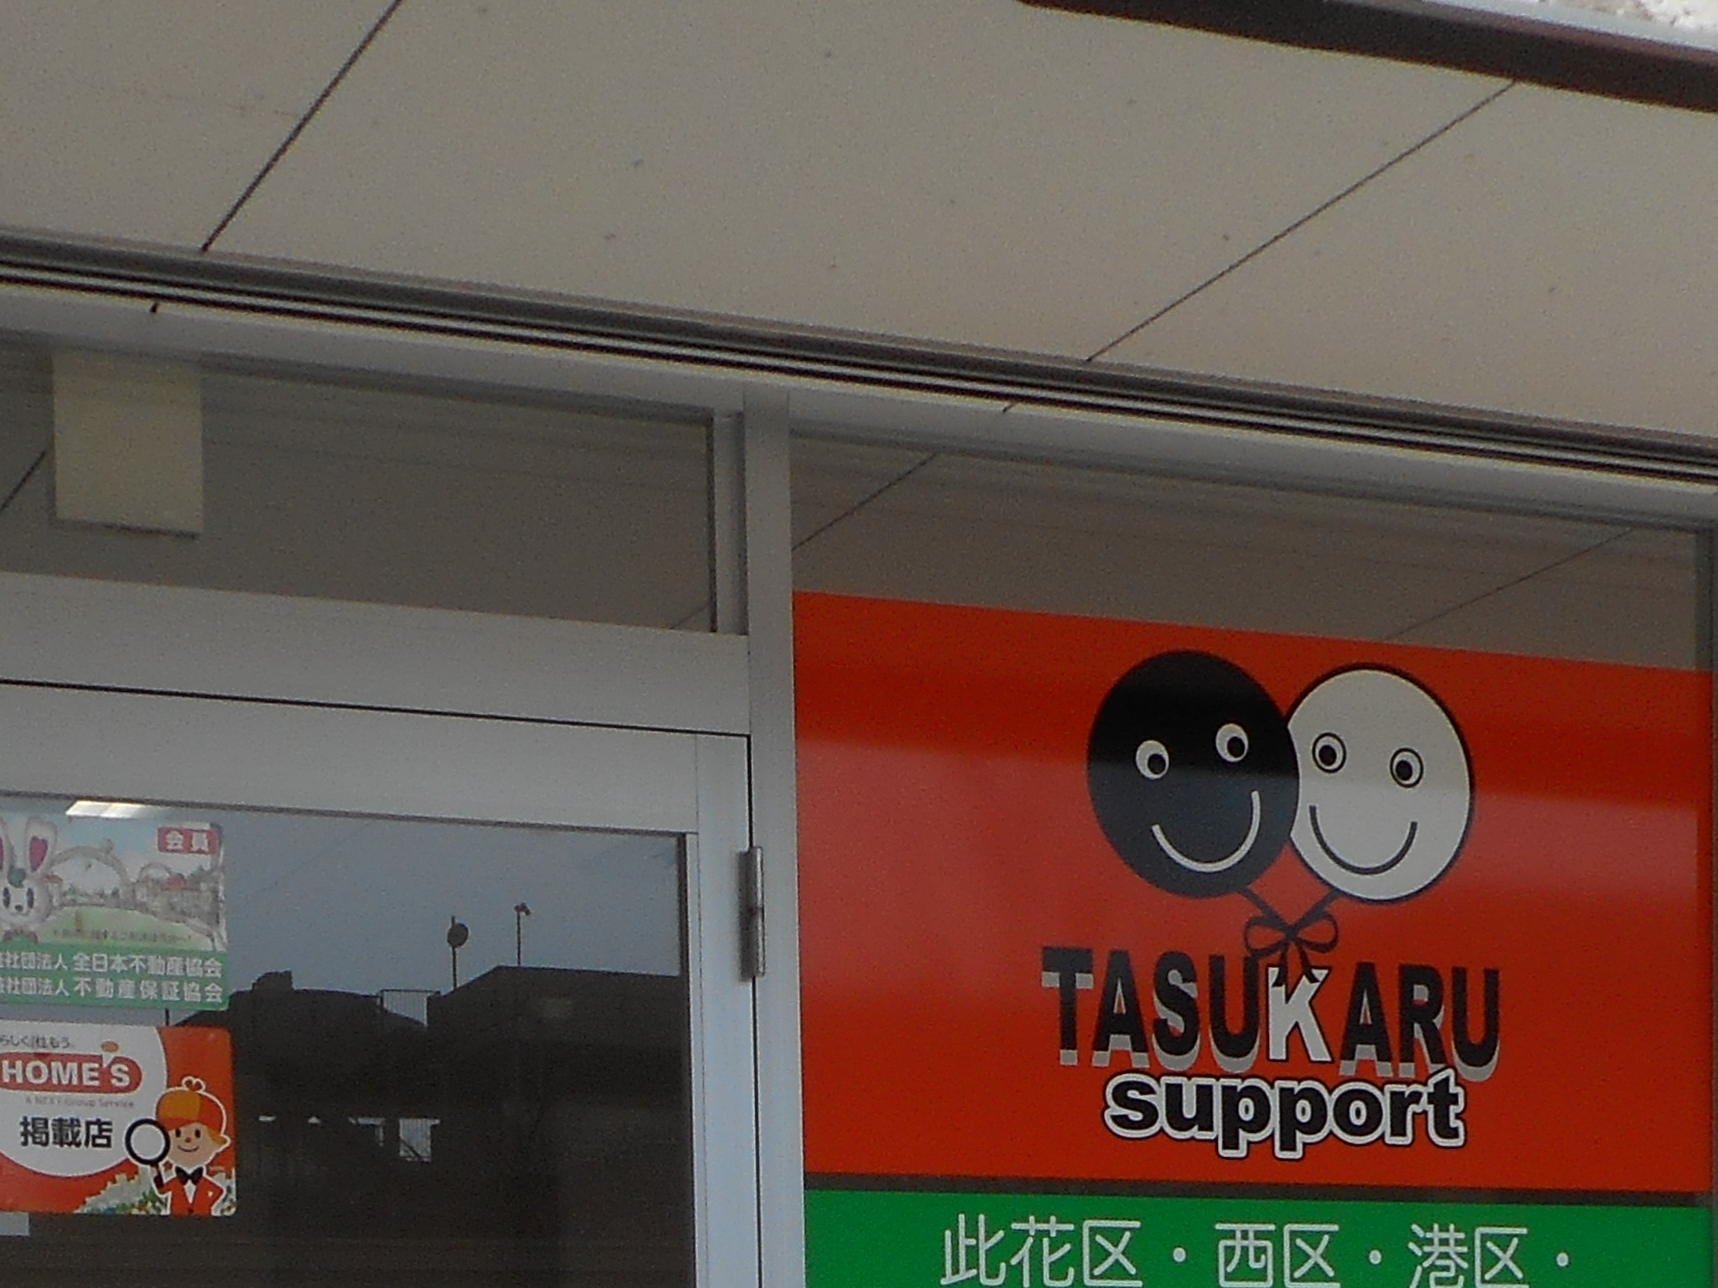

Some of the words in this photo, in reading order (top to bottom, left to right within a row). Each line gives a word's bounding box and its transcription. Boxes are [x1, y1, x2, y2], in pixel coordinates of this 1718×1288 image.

[165, 830, 211, 851] 会員
[73, 953, 223, 979] 全日本不動産協会
[73, 977, 223, 1003] 不動産保証協会
[1041, 945, 1500, 1081] TASUKARU
[1, 1059, 132, 1087] HOME'S
[1105, 1066, 1465, 1158] support
[19, 1117, 113, 1149] 掲載店
